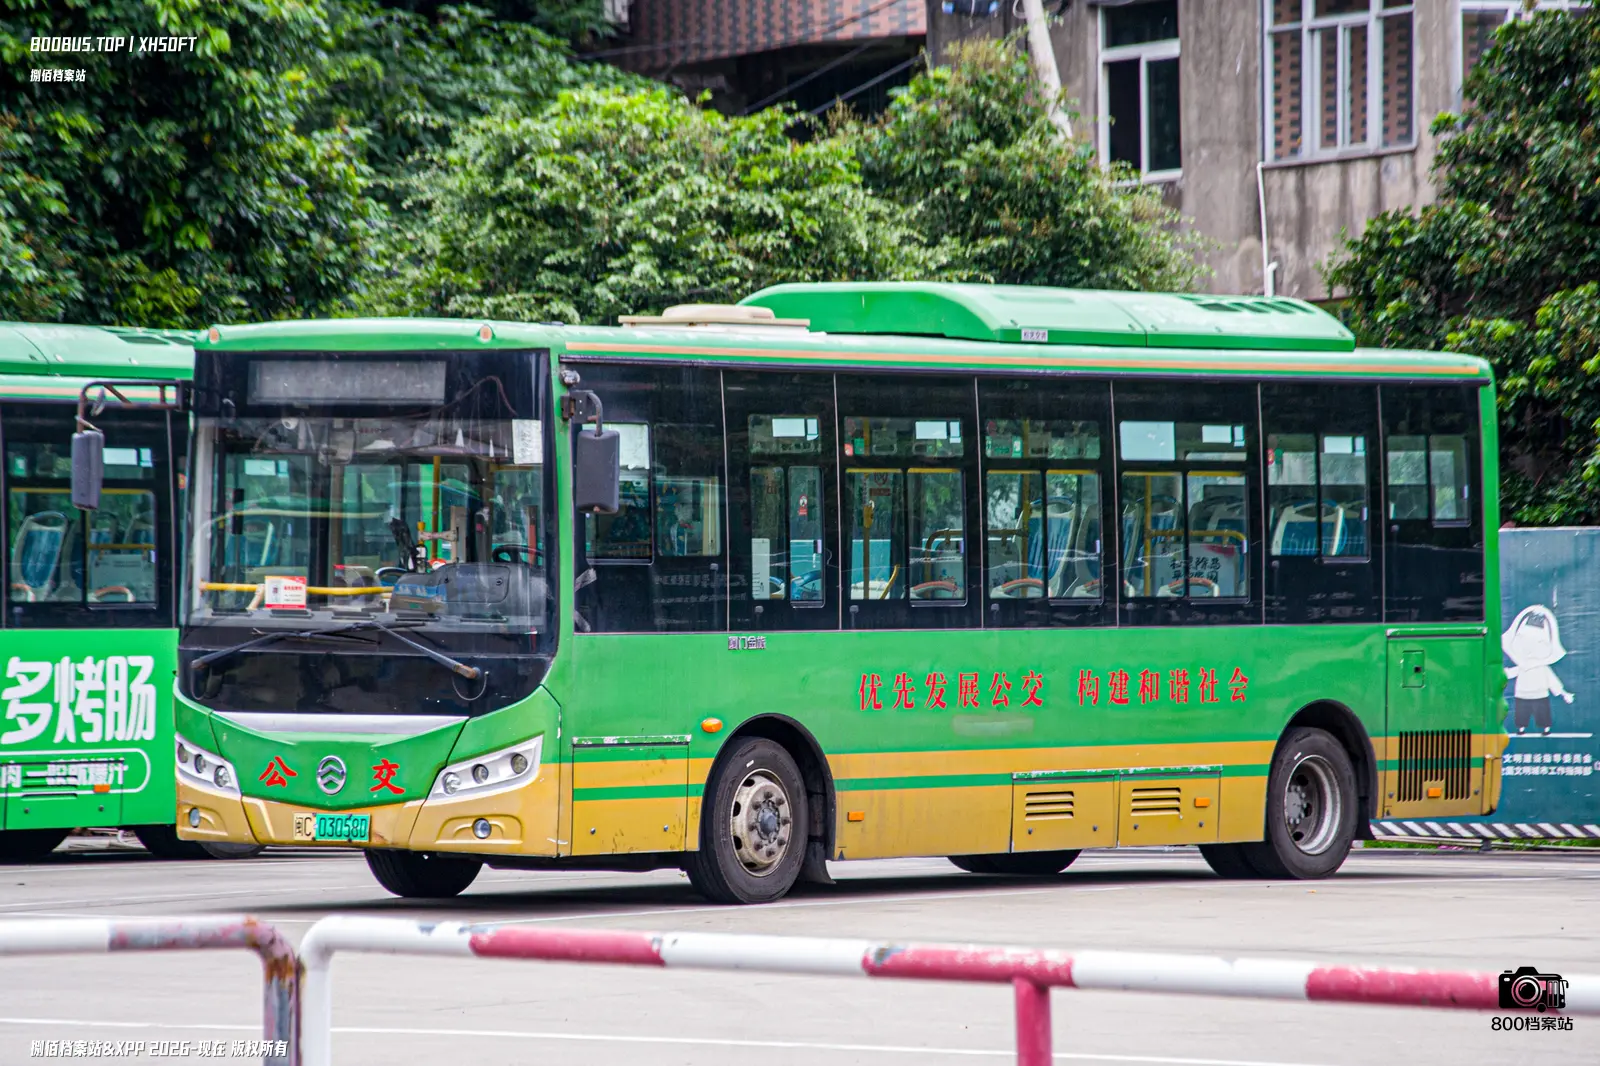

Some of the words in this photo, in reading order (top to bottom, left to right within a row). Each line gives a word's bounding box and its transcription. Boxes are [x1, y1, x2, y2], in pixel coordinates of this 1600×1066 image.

[1, 656, 156, 744] 多烤肠
[858, 670, 1044, 711] 优先发展公交
[1077, 666, 1249, 706] 构建和谐社会
[259, 756, 297, 788] 公
[369, 758, 405, 795] 交
